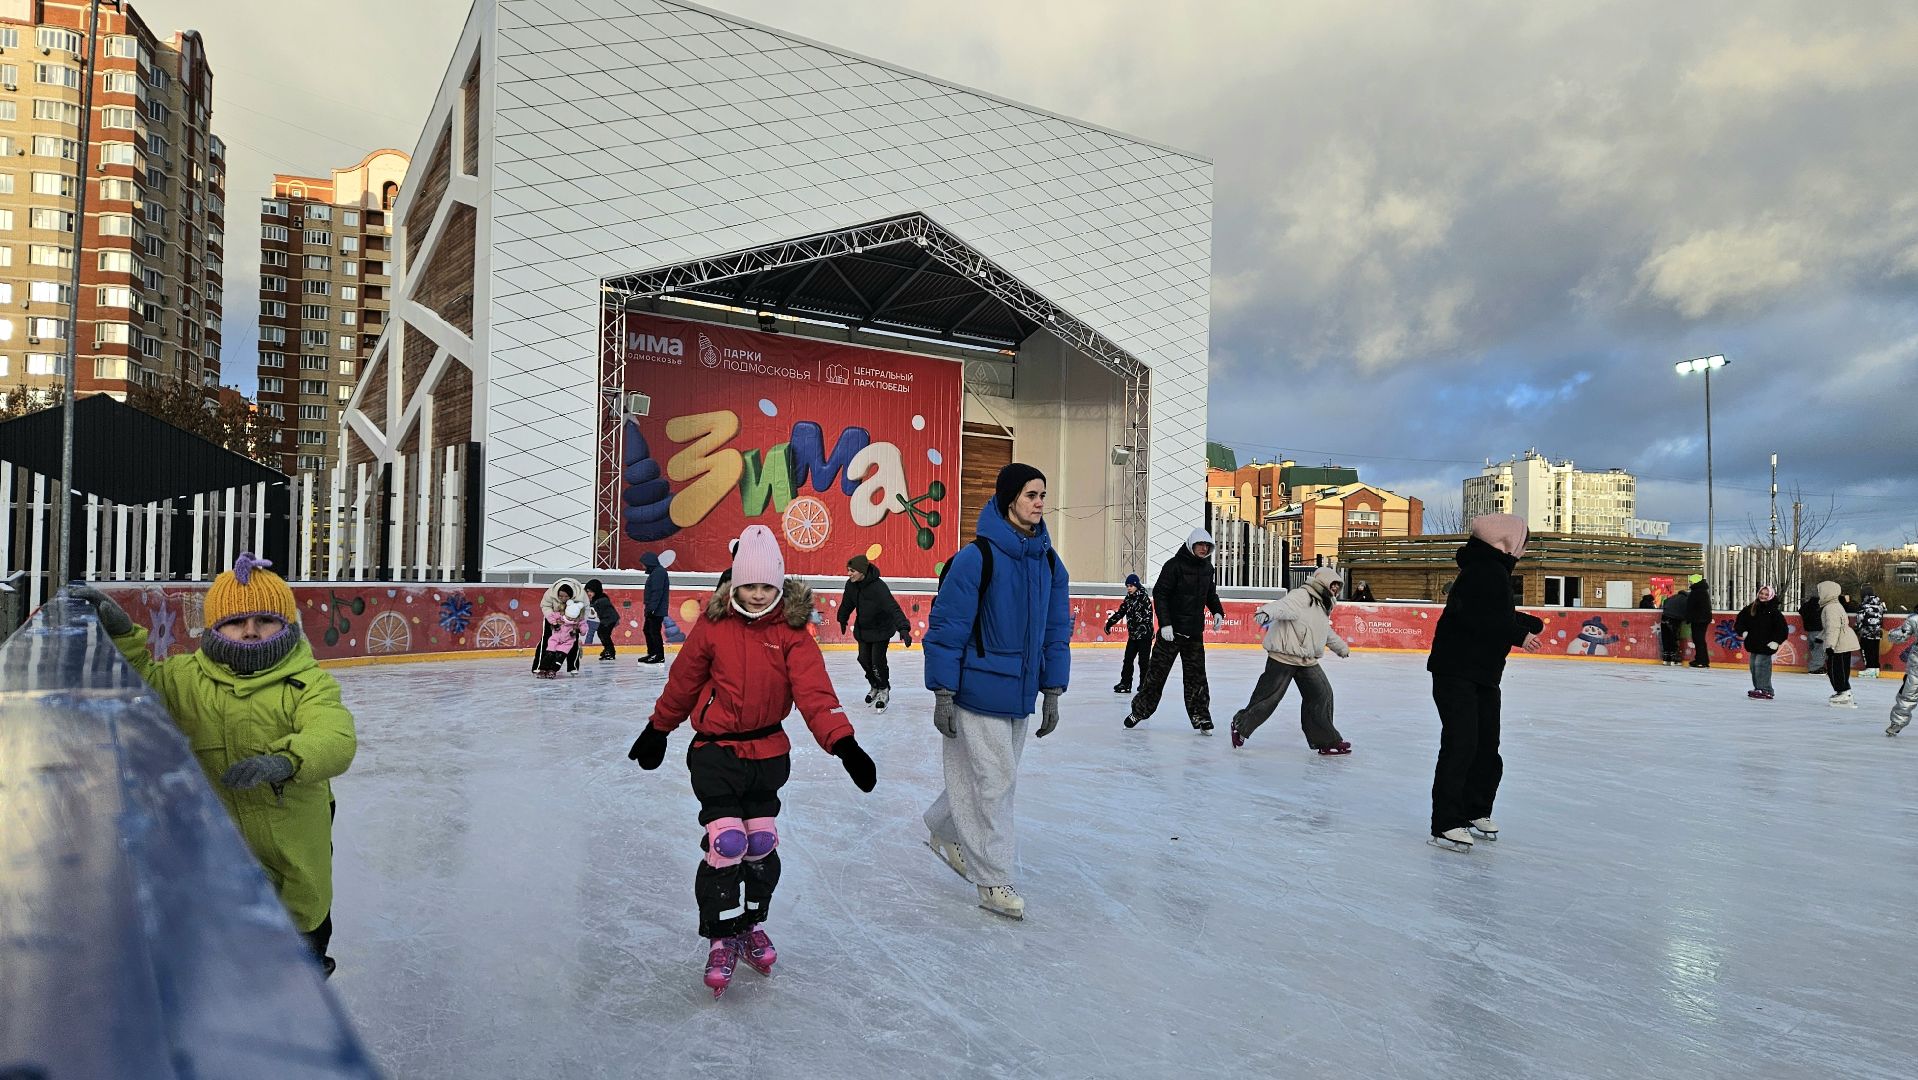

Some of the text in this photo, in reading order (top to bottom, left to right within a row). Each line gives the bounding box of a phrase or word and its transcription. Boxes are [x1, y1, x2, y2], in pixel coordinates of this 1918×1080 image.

[626, 331, 684, 357] има
[626, 351, 683, 366] одмосковье
[723, 348, 762, 362] ПАРКИ
[722, 359, 811, 381] ПОДМОСКОВЬЯ
[853, 366, 914, 382] ЦЕНТРАЛЬНЫЙ
[853, 378, 910, 393] ПАРК ПОБЕДЫ
[1624, 518, 1671, 538] ПРОКАТ
